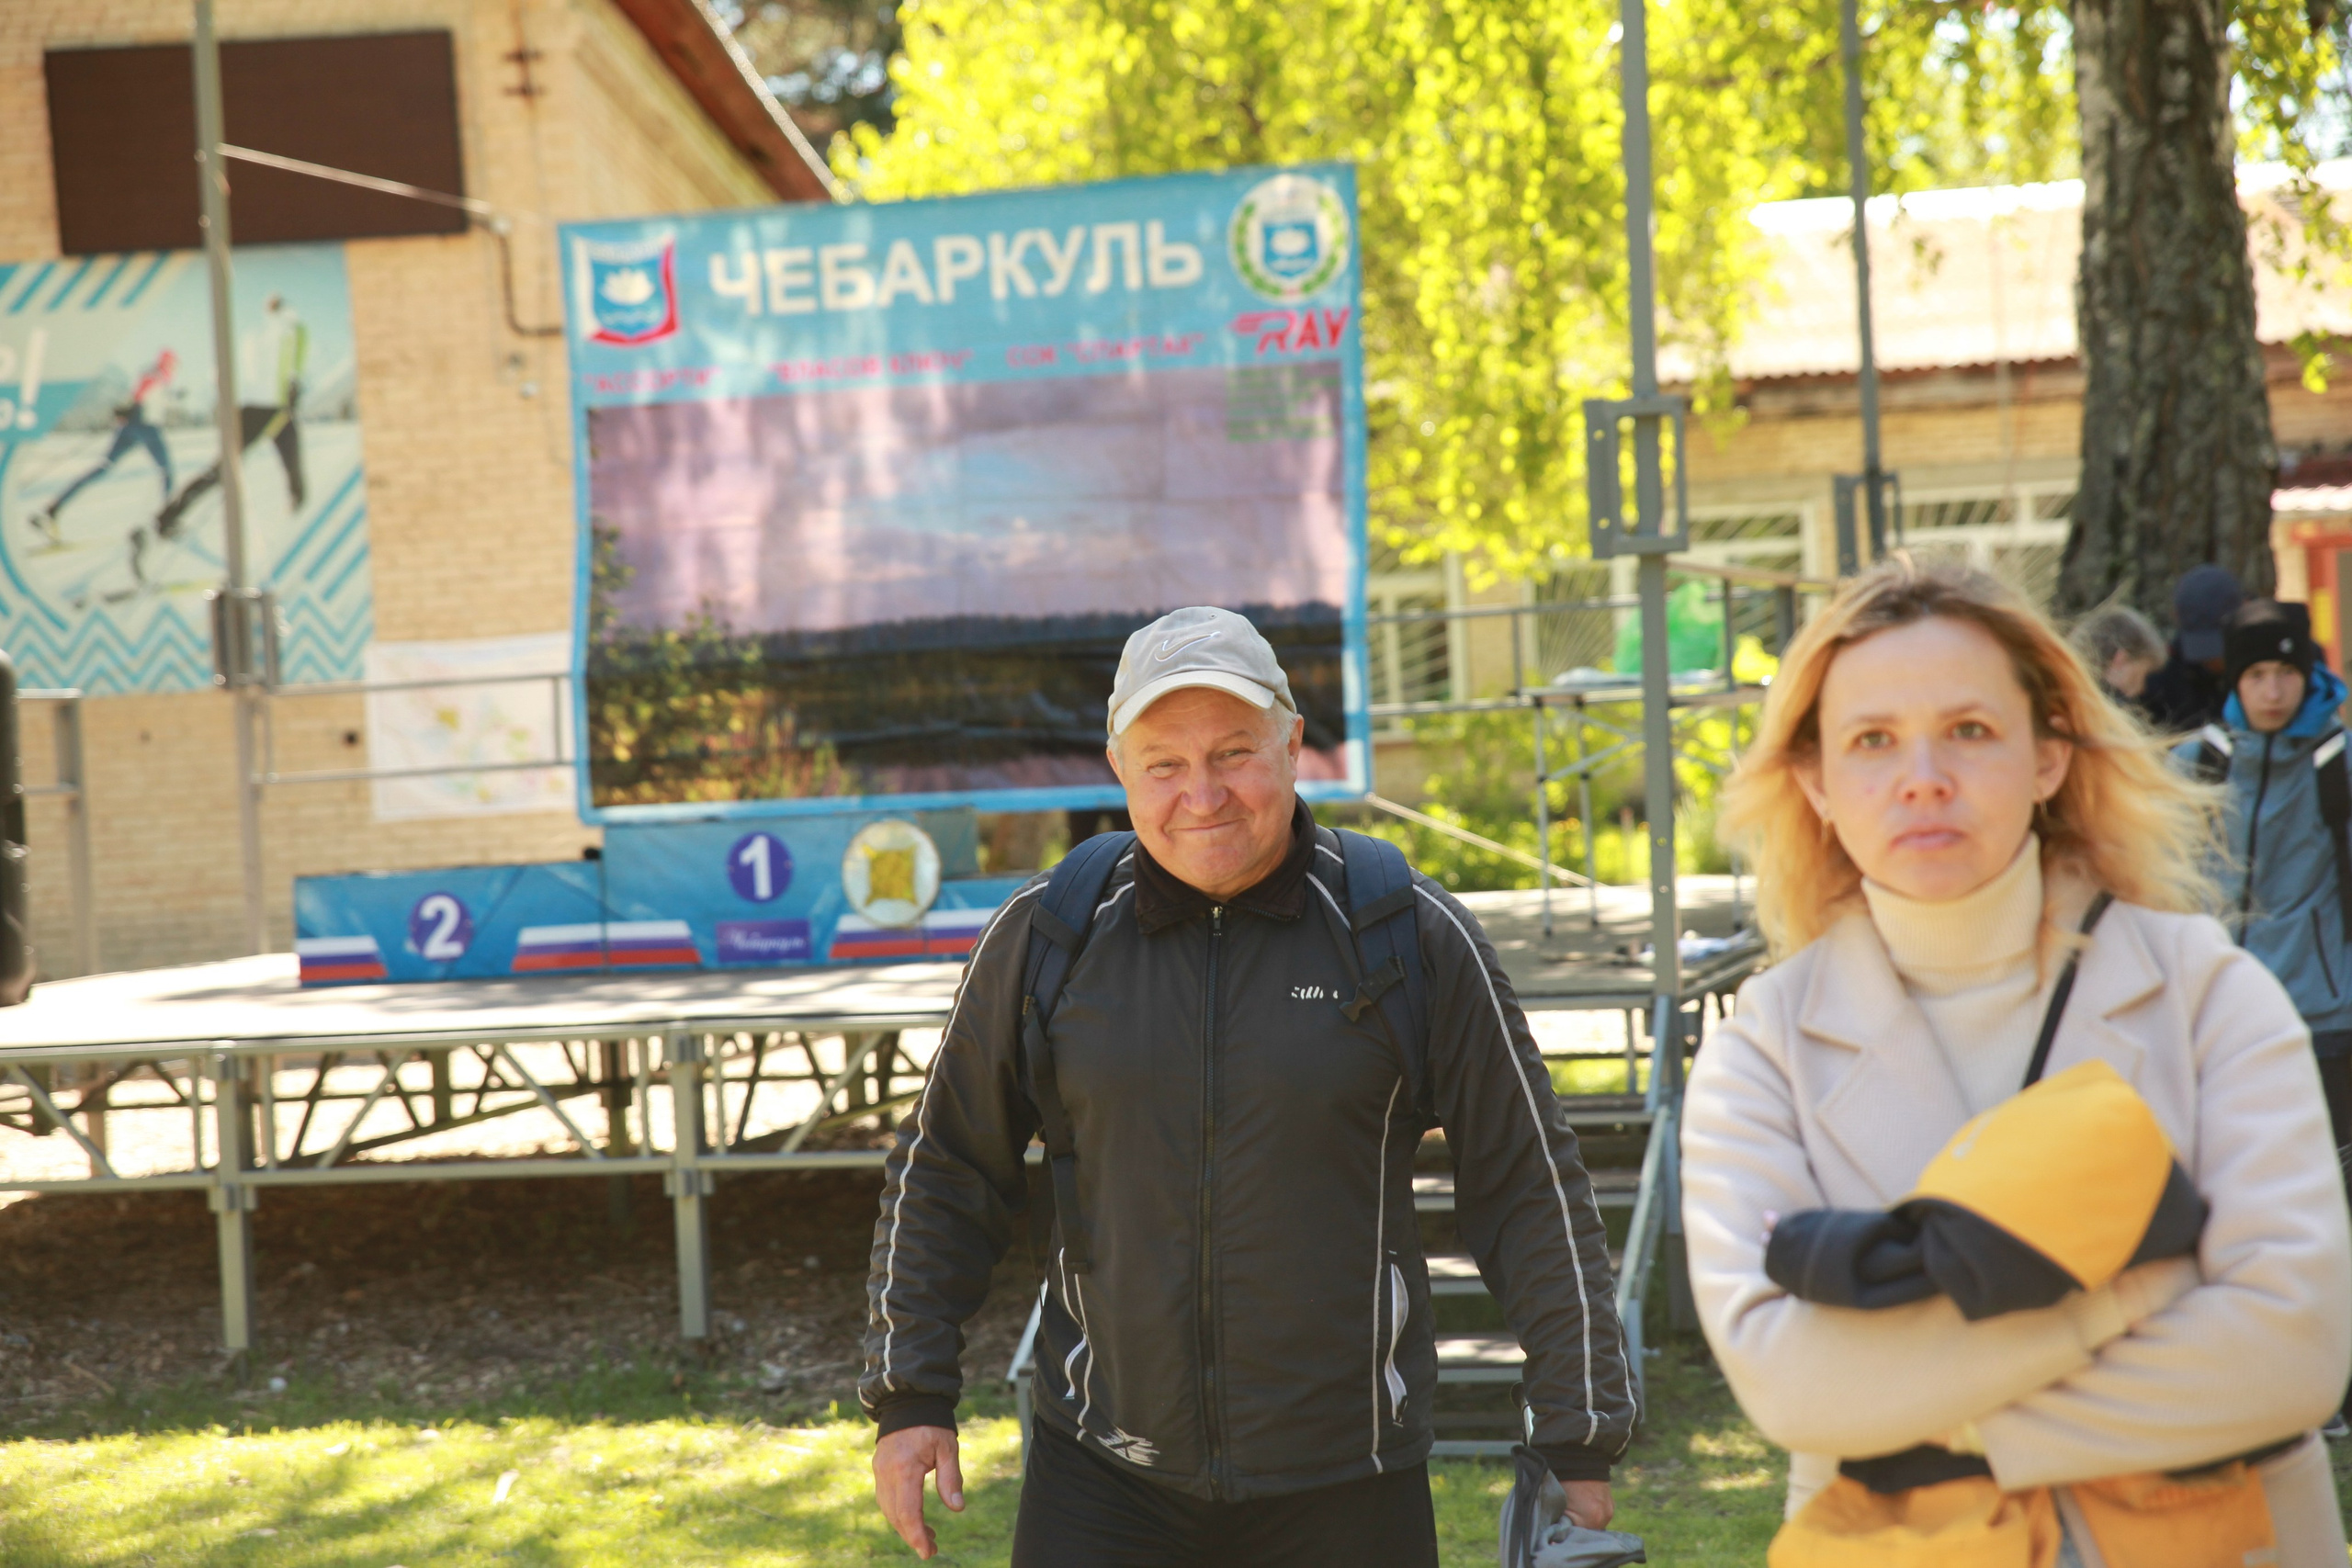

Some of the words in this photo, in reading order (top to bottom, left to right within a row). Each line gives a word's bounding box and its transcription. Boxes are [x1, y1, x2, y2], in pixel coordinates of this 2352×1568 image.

[708, 220, 1204, 316] ЧЕБАРКУЛЬ
[1227, 306, 1351, 355] RAY
[739, 834, 773, 899] 1
[419, 894, 464, 960] 2
